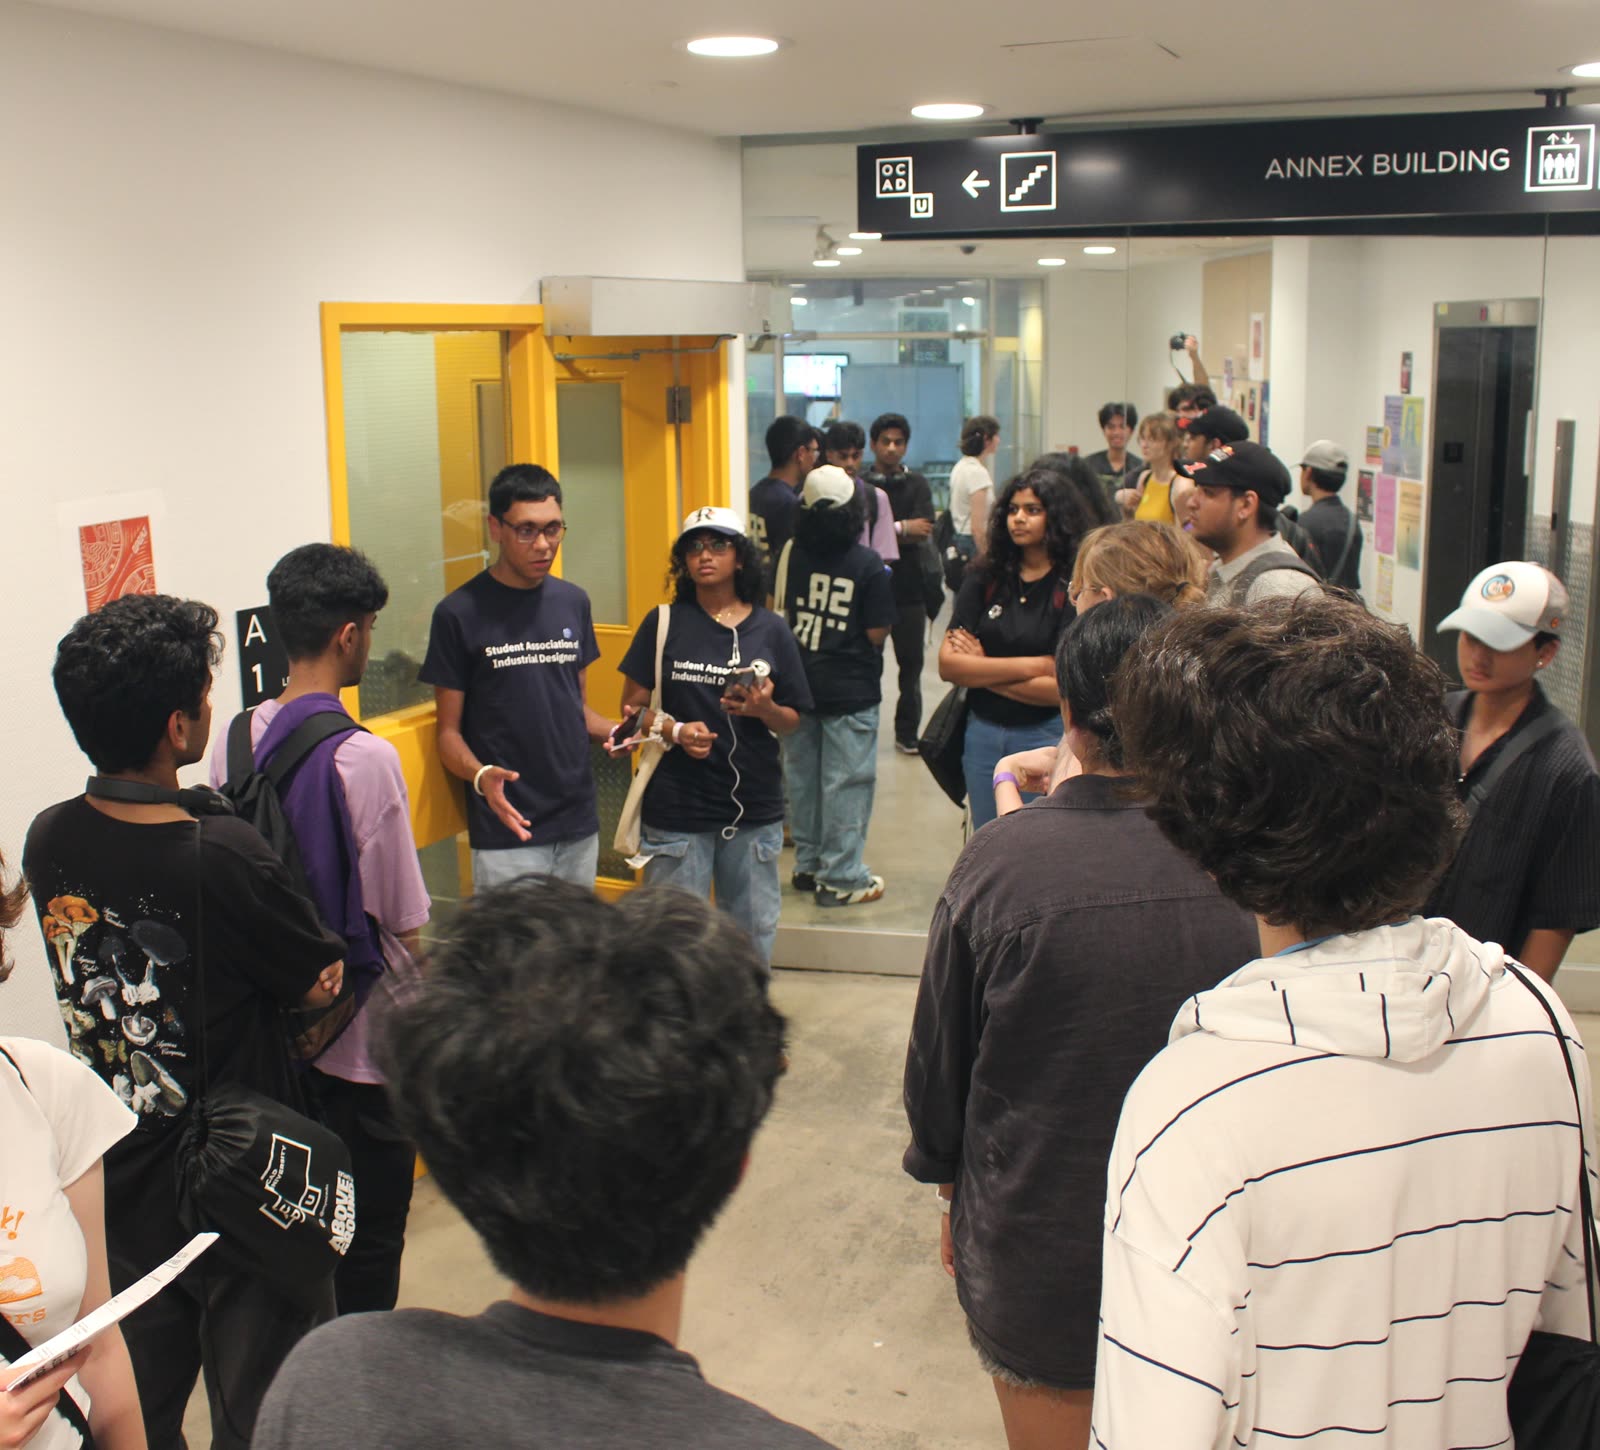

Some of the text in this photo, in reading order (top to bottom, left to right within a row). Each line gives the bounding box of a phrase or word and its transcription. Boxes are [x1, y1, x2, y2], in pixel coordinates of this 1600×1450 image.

[1265, 148, 1511, 179] ANNEX BUILDING
[915, 198, 928, 213] U
[244, 613, 268, 647] A
[485, 642, 525, 657] Student
[525, 638, 573, 651] Association
[492, 653, 538, 669] Industrial
[673, 660, 705, 672] tudent
[251, 663, 264, 693] 1
[671, 670, 717, 686] Industrial
[271, 1144, 287, 1188] NIVERSITY
[328, 1176, 349, 1252] ABOVE
